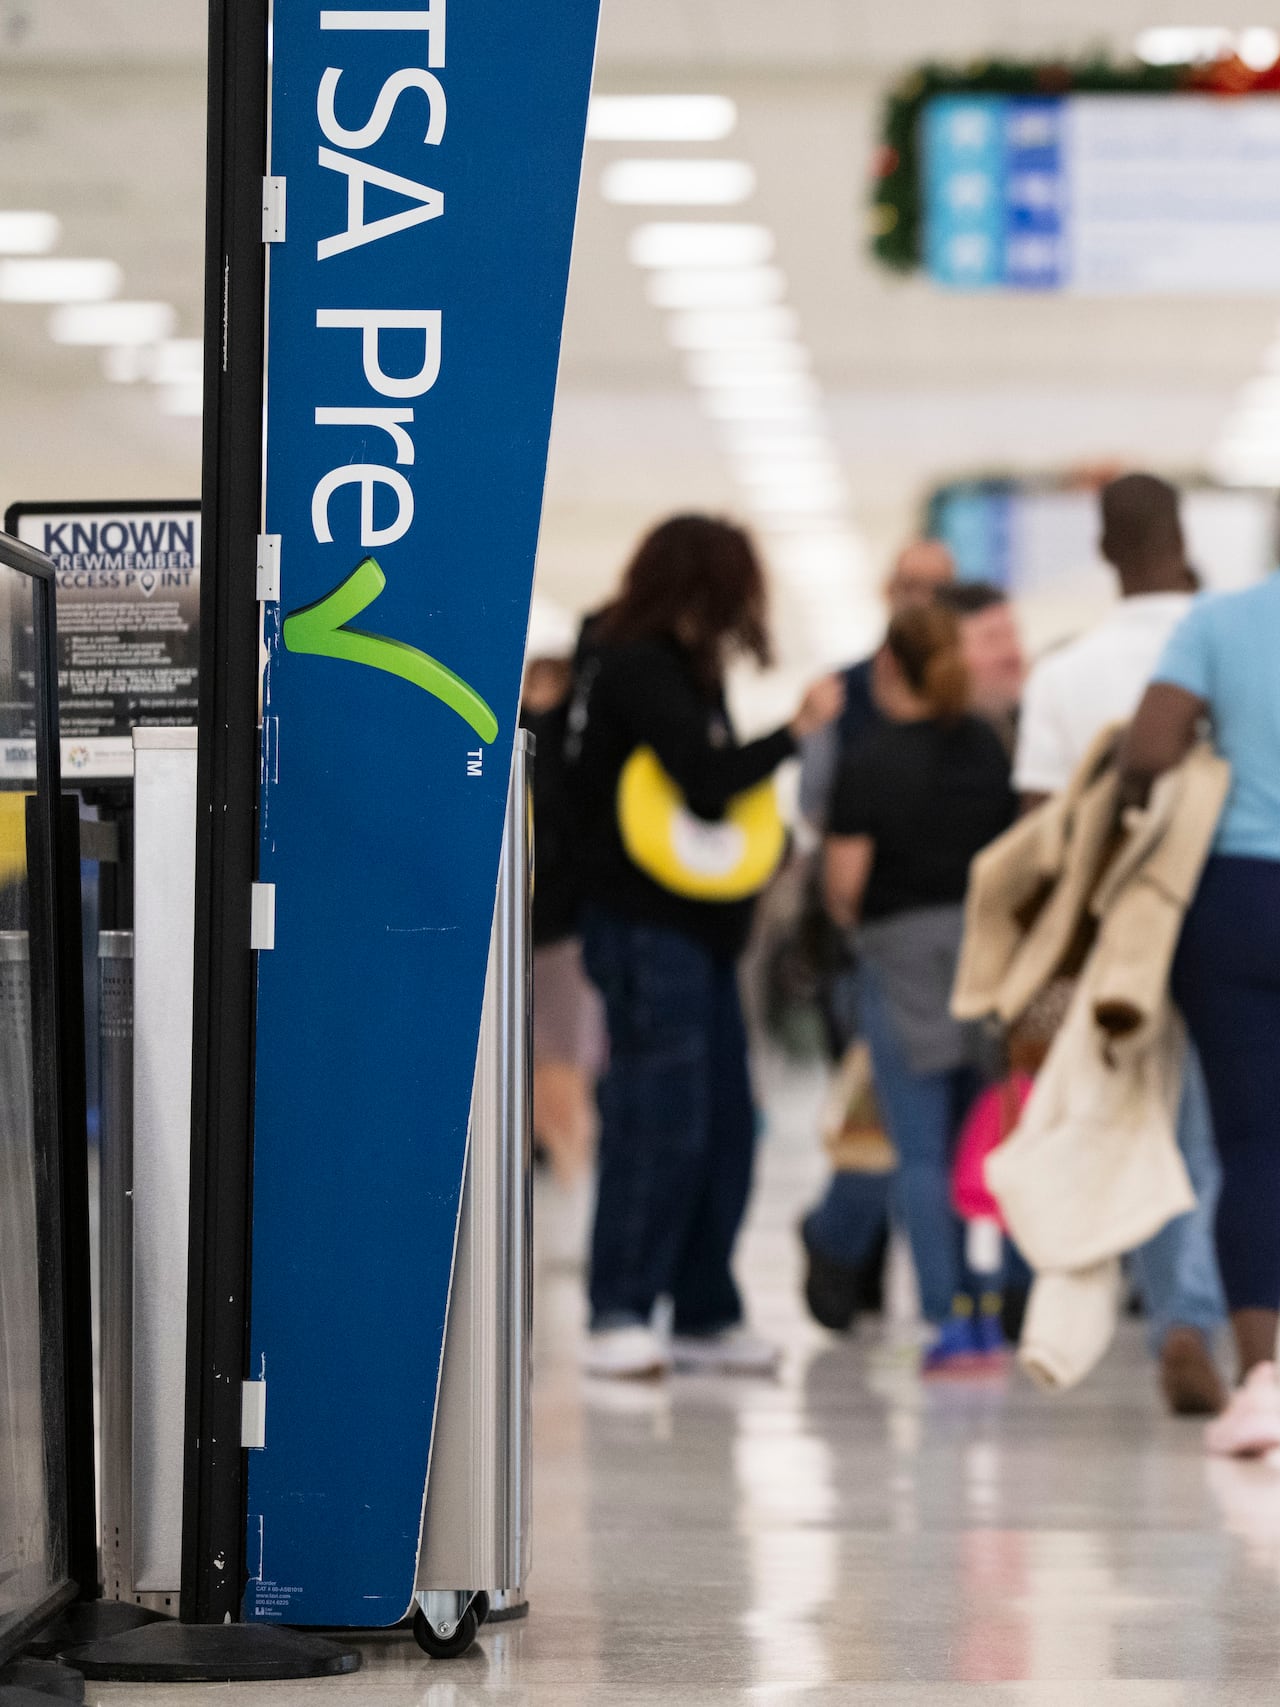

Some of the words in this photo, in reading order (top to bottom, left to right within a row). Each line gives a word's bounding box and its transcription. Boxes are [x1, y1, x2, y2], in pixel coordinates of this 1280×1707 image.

[316, 0, 446, 262] TSA
[44, 521, 194, 554] KNOWN
[311, 308, 442, 547] Pre
